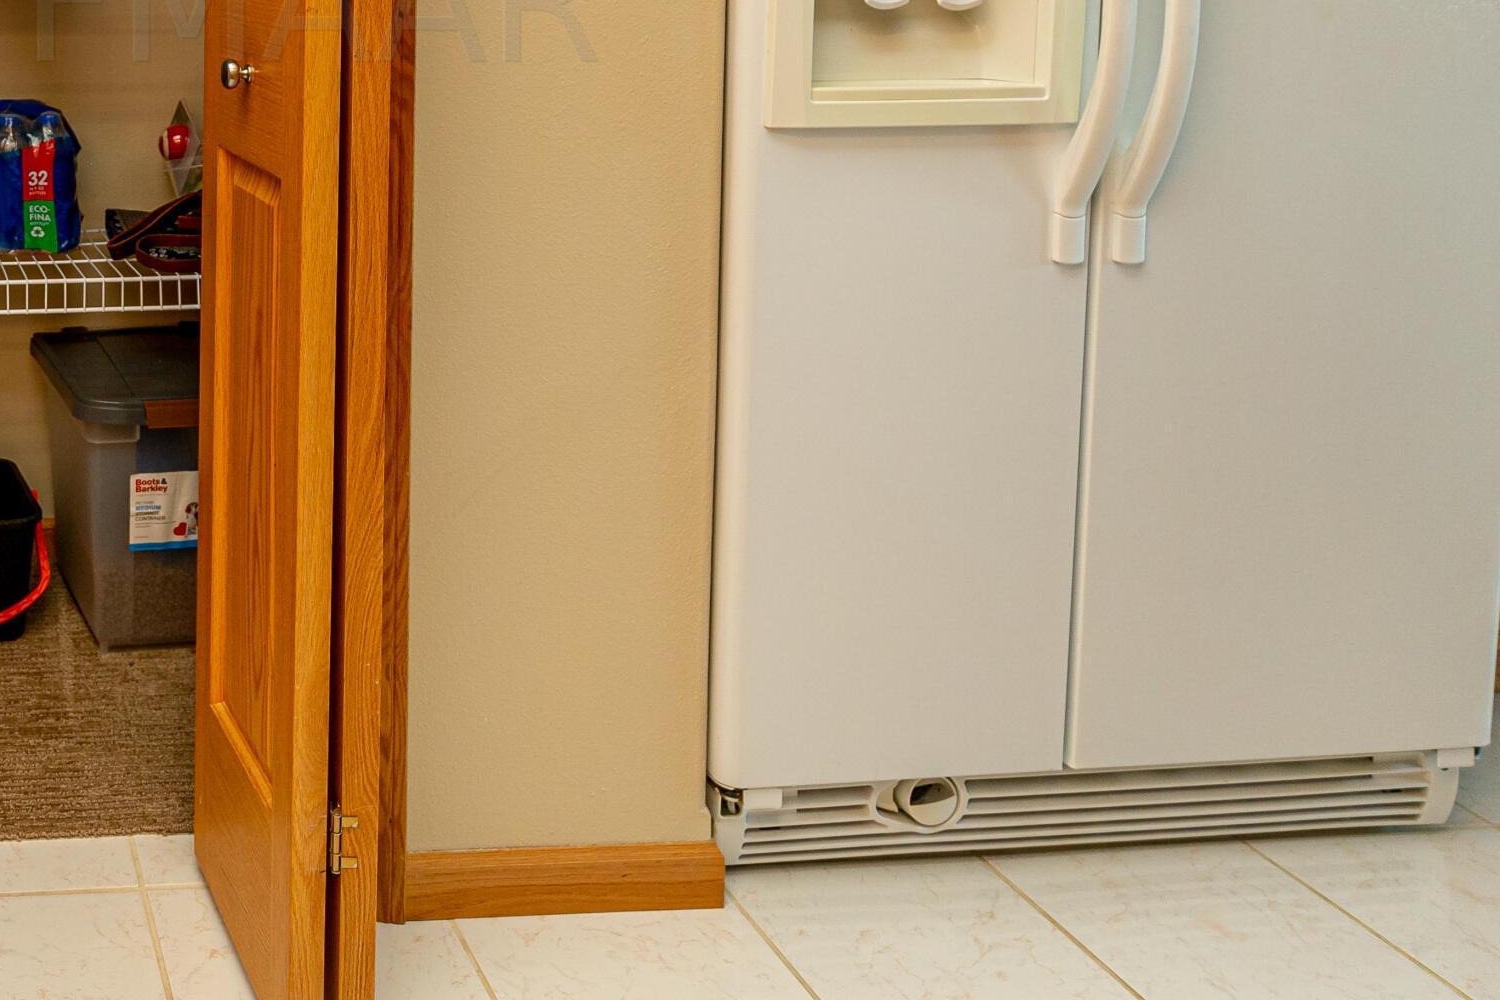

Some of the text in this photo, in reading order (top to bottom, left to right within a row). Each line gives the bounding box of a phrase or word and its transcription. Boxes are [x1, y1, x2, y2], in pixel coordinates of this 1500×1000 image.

[28, 170, 48, 186] 32
[29, 205, 50, 213] ECO-
[29, 213, 51, 222] FINA
[135, 478, 160, 486] Boots
[135, 485, 168, 493] Barkley
